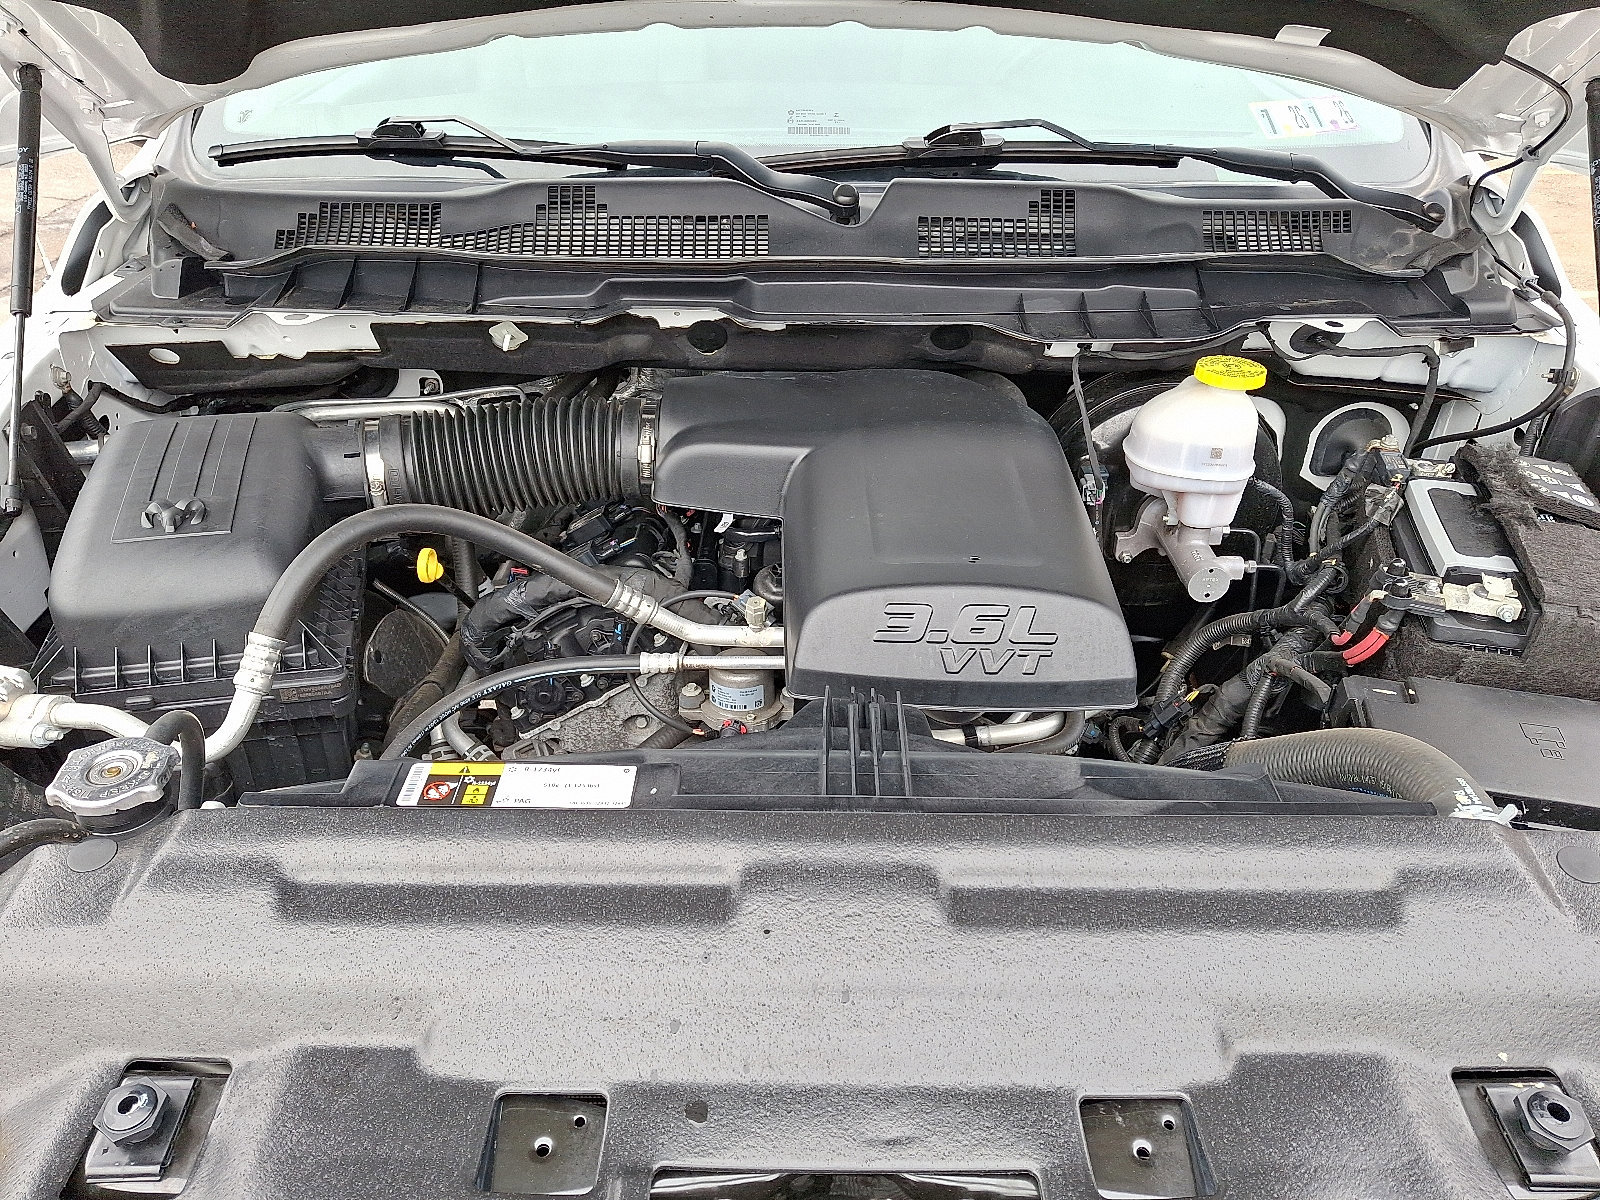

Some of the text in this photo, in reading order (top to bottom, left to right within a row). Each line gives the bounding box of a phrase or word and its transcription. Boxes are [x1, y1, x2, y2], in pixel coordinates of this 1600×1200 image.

[873, 602, 1059, 645] 3.6L
[940, 647, 1054, 675] VVT
[482, 680, 512, 696] GALAXY
